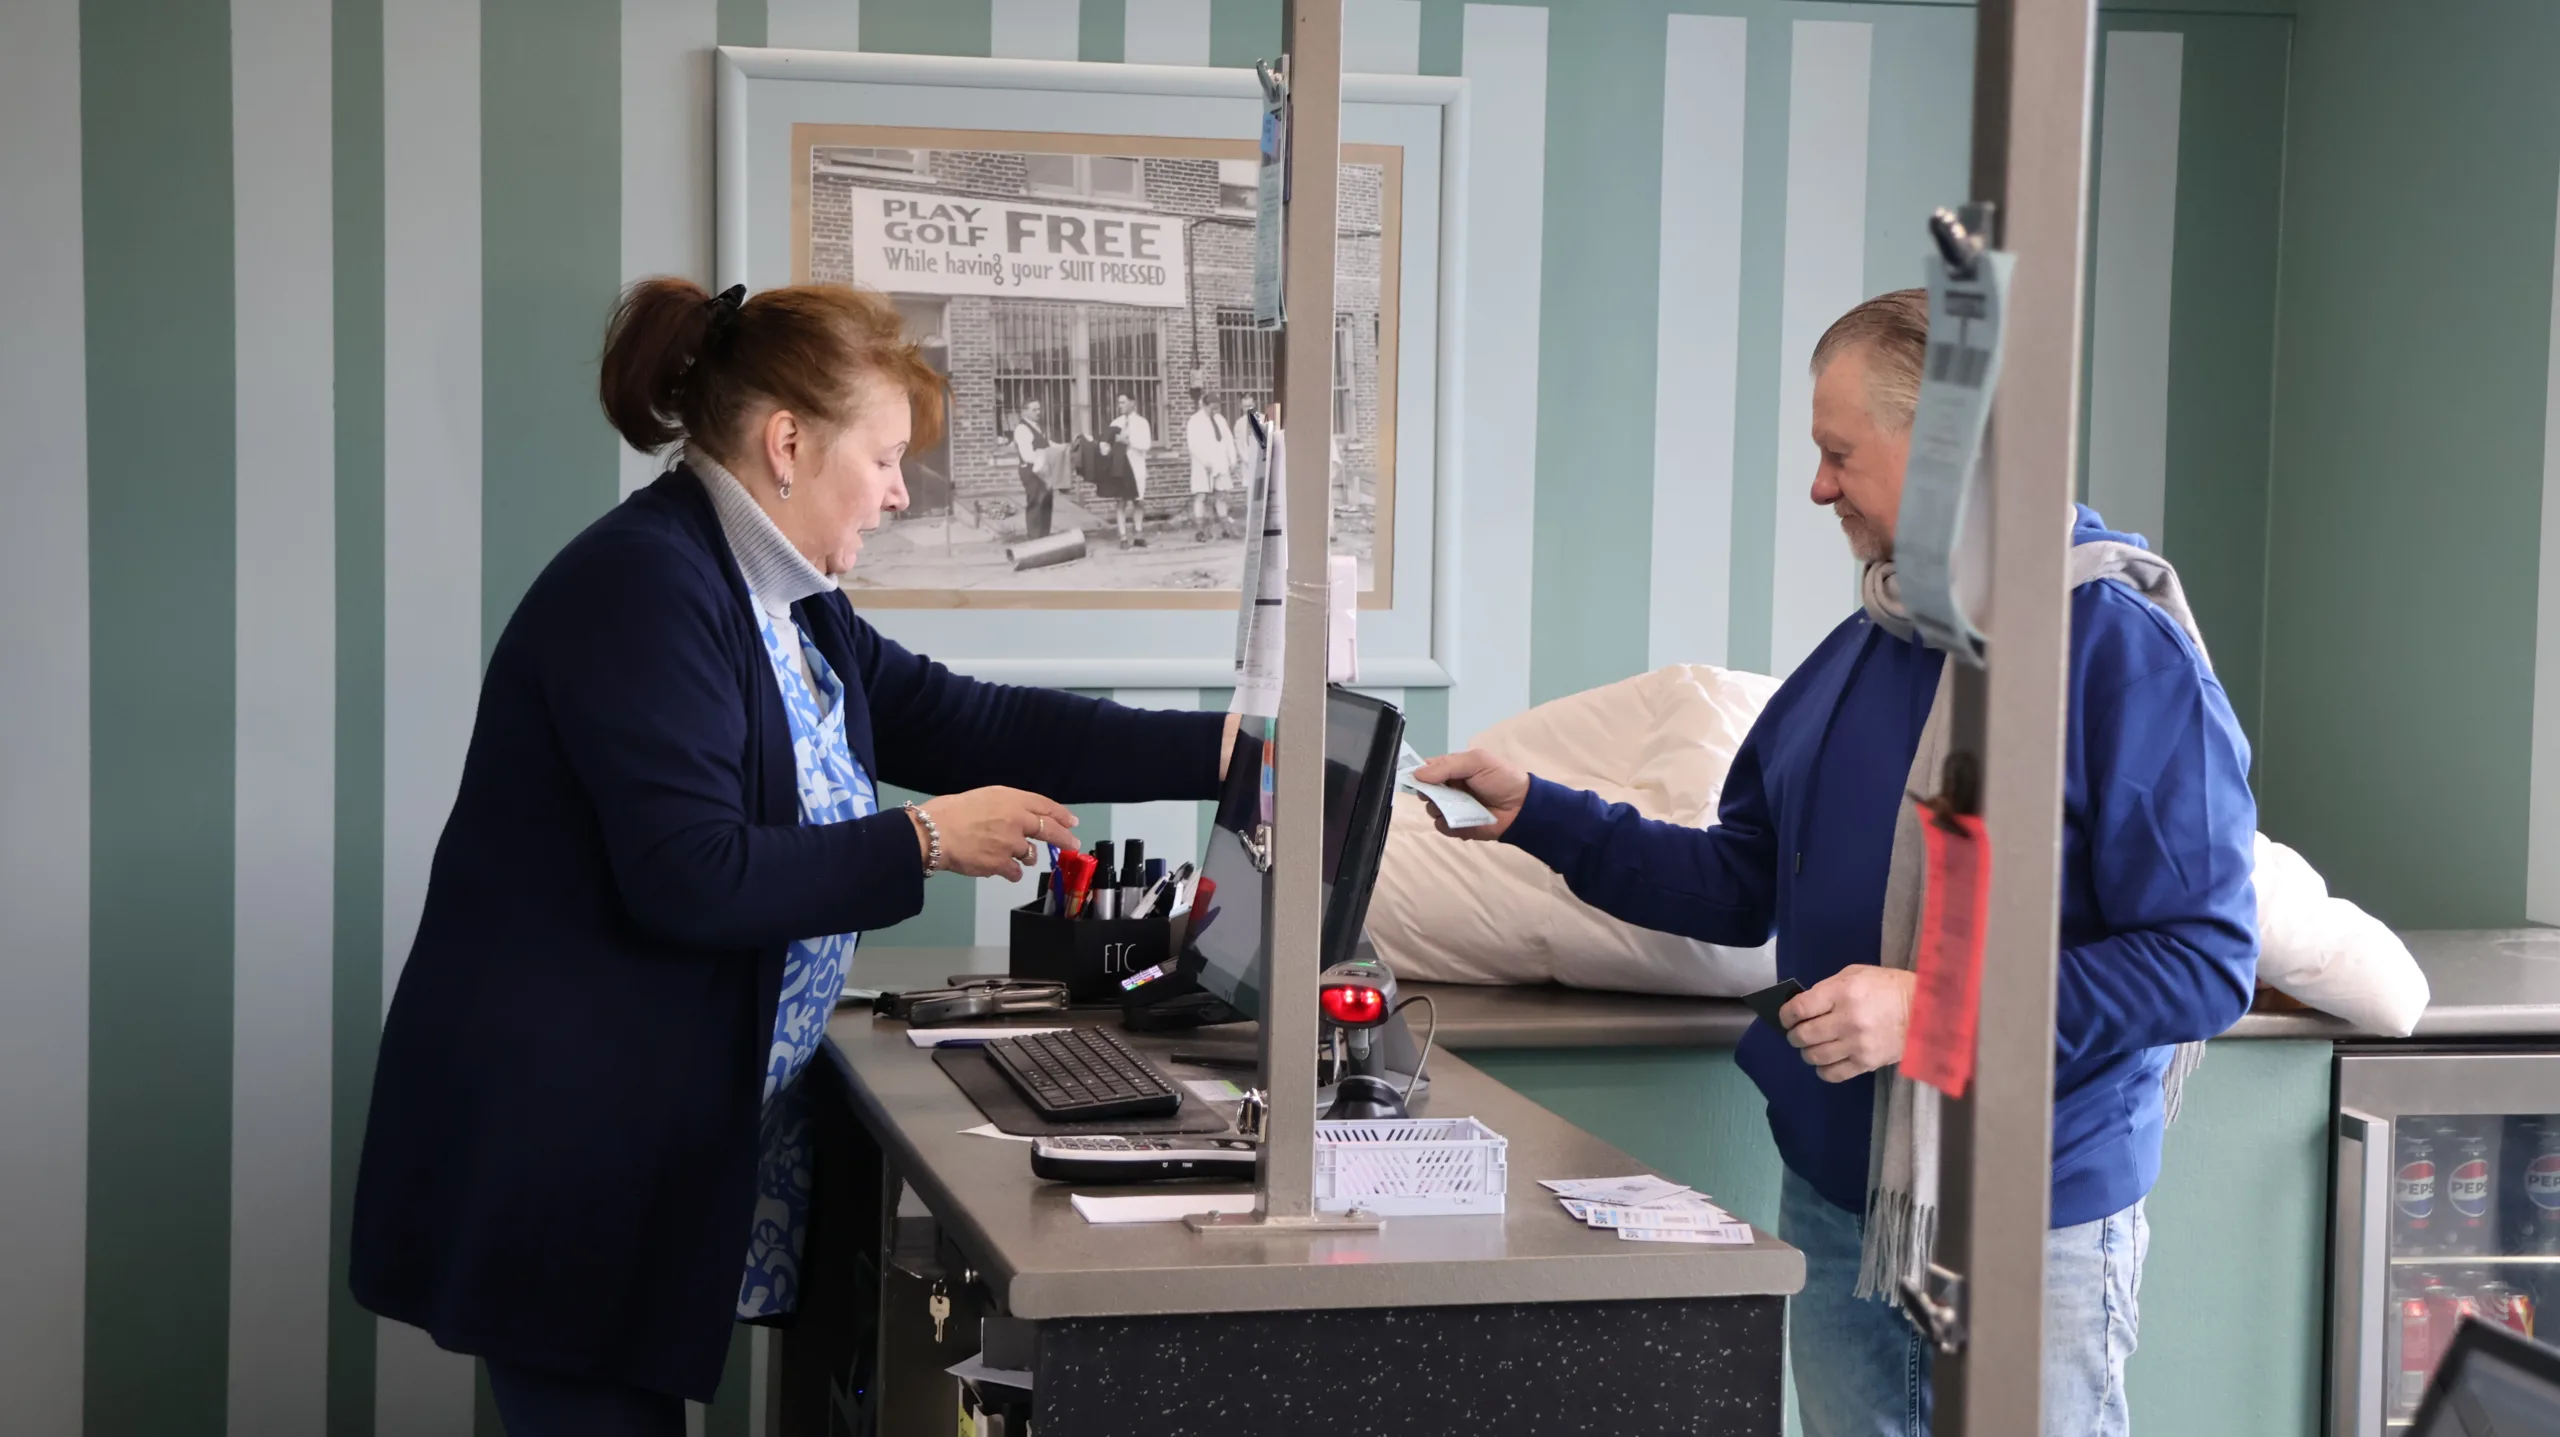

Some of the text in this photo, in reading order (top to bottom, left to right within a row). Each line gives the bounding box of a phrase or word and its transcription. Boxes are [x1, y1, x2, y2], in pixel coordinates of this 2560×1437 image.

[882, 198, 982, 223] PLAY
[883, 221, 988, 247] GOLF
[1005, 210, 1161, 260] FREE
[882, 247, 1166, 287] While having your SUIT PRESSED
[1104, 943, 1137, 973] ETC
[2396, 1181, 2434, 1195] PEPS
[2528, 1174, 2560, 1187] PEP
